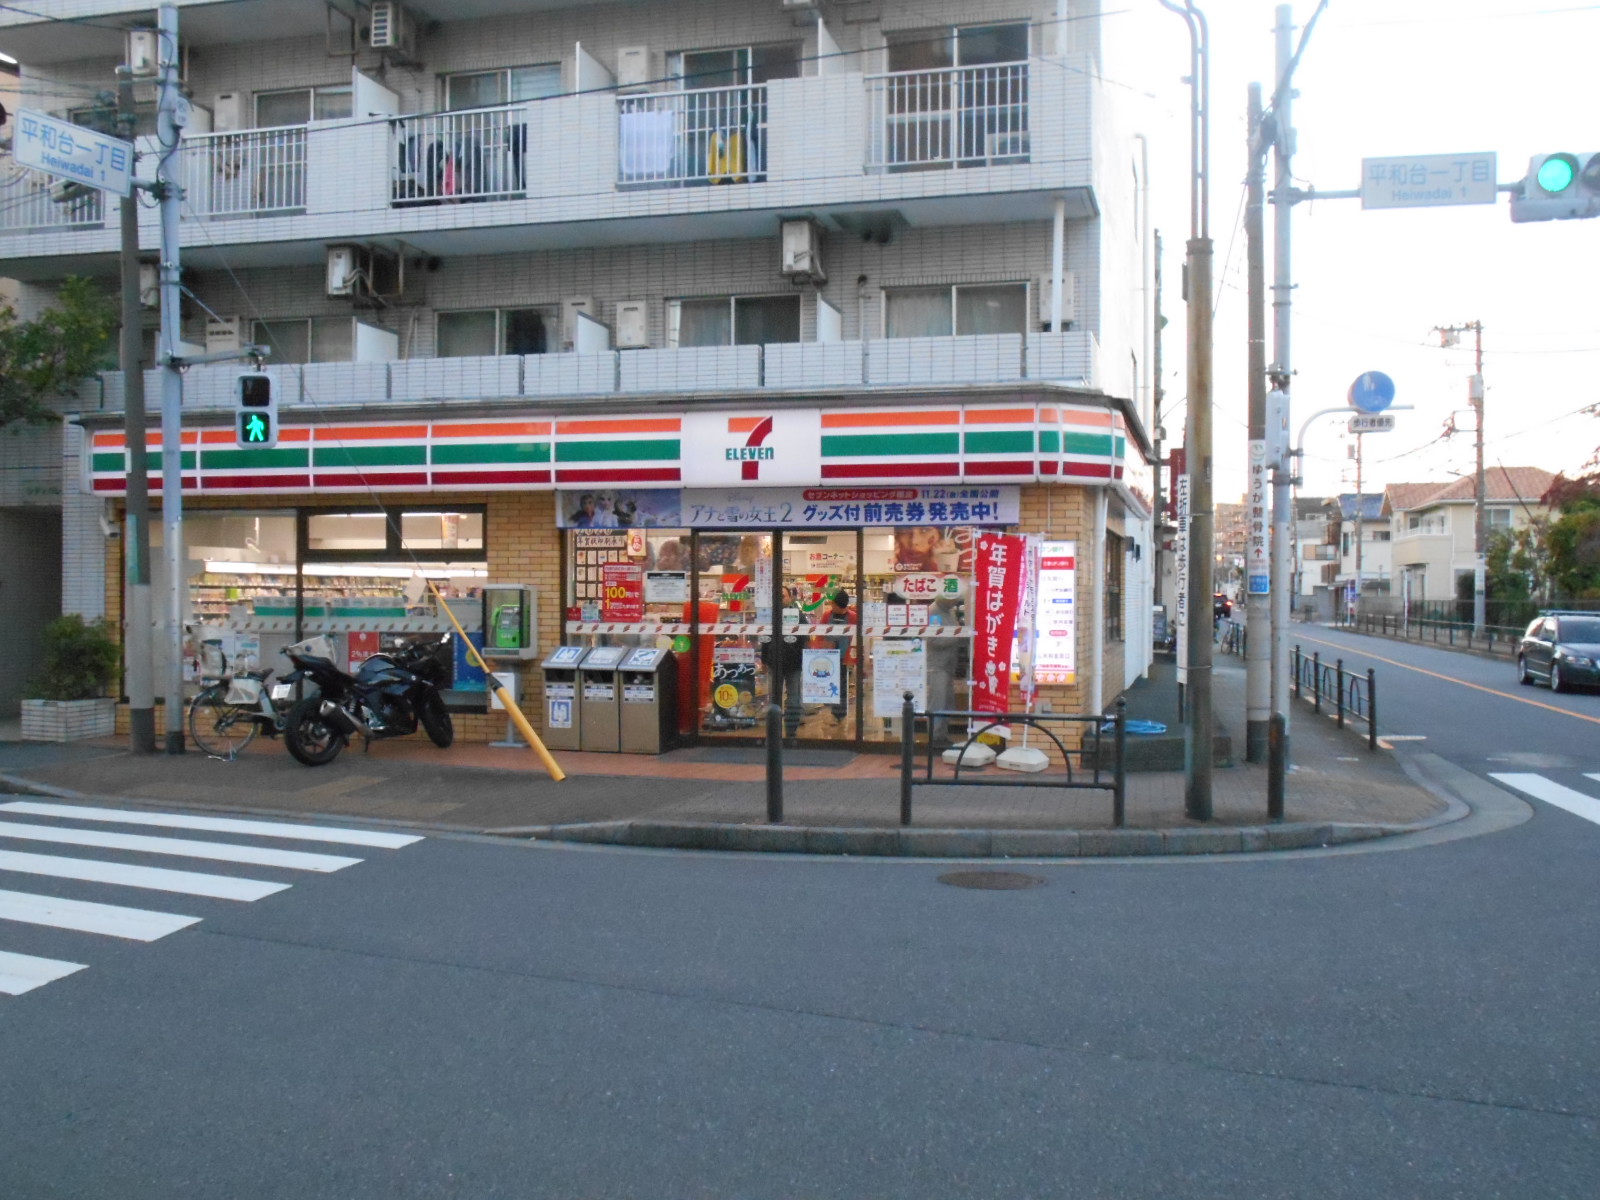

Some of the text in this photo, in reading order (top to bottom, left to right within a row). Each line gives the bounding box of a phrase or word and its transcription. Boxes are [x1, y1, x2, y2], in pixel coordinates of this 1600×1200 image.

[22, 117, 126, 172] 平和台一丁目
[41, 152, 106, 182] Heiwadai 1
[1368, 160, 1490, 186] 平和台一丁目
[1391, 186, 1468, 200] Heiwadai 1
[690, 502, 793, 522] アナと雪の女王2
[1252, 464, 1264, 547] ゆうが整骨院
[904, 578, 958, 592] たばこ 酒
[986, 542, 1008, 657] 年賀はがき
